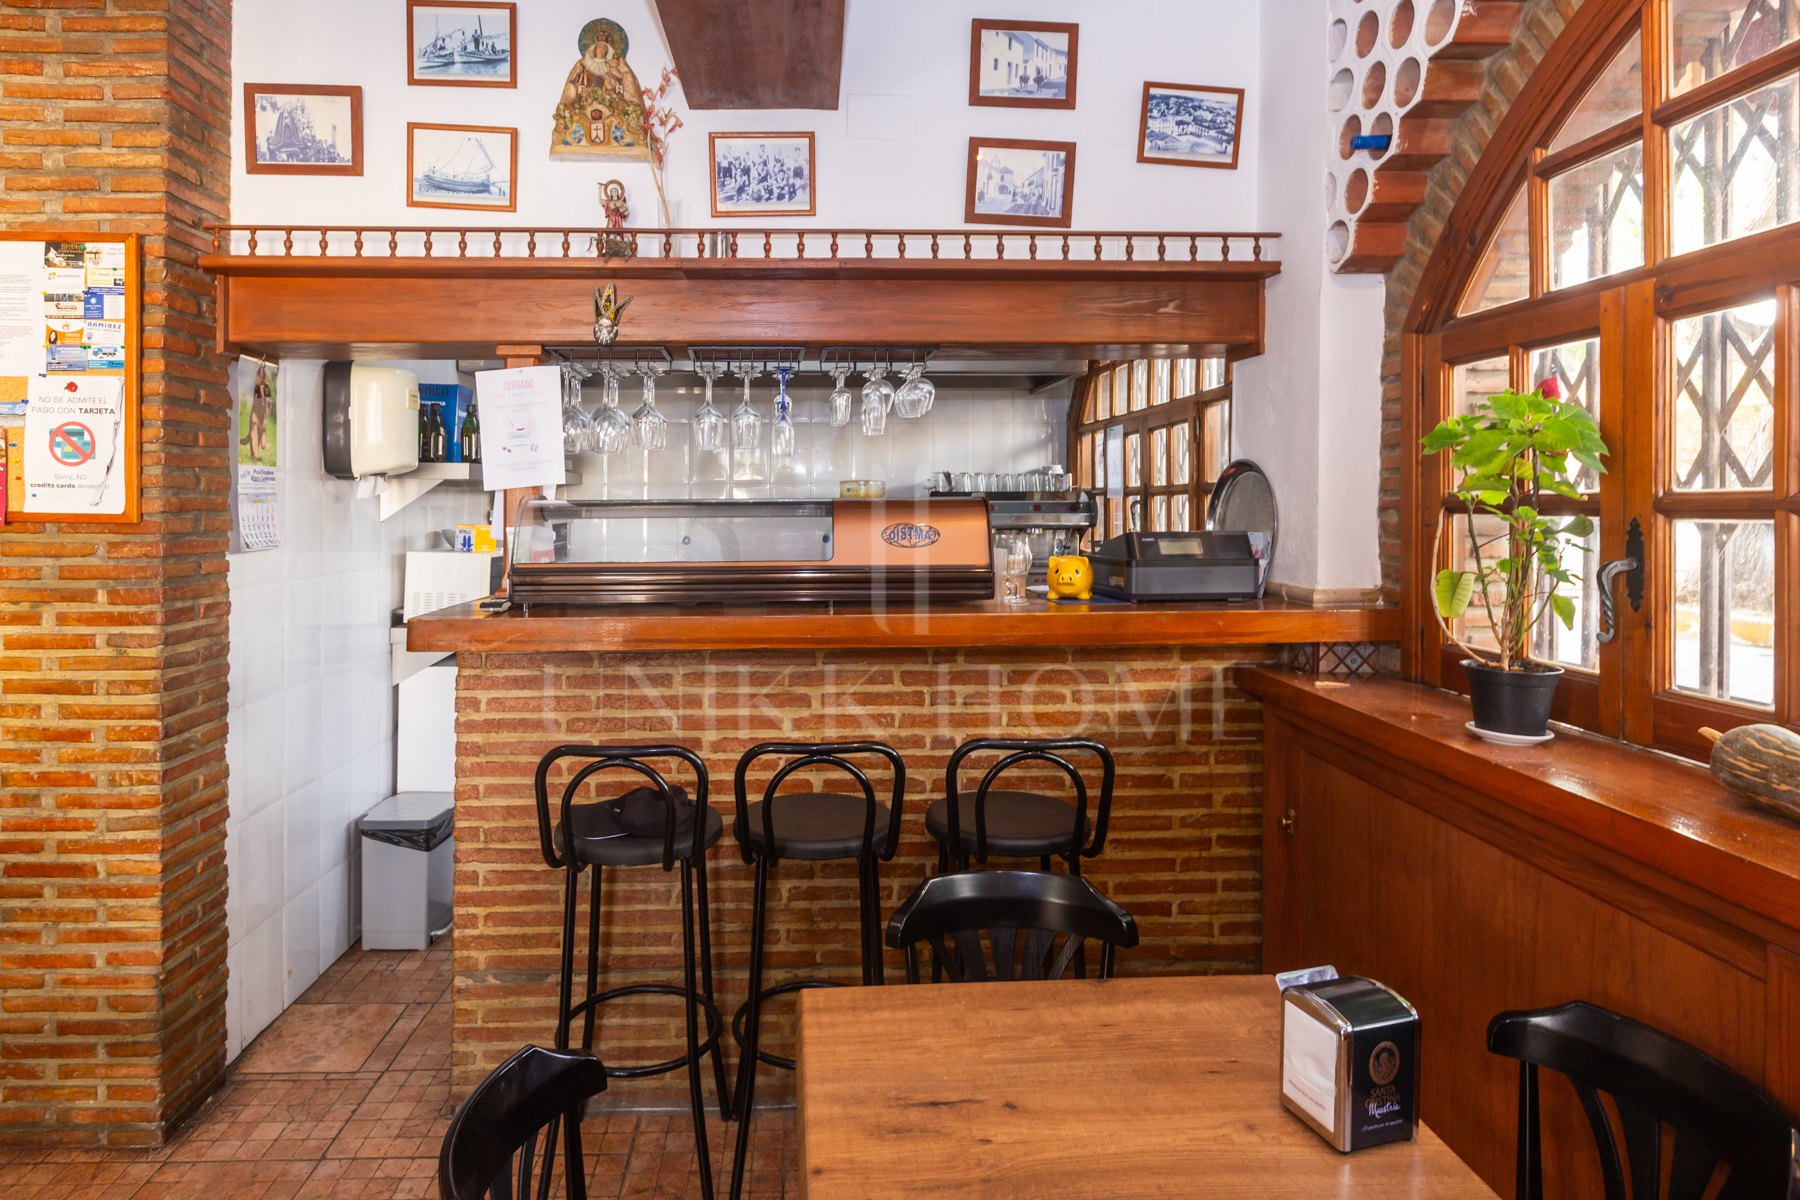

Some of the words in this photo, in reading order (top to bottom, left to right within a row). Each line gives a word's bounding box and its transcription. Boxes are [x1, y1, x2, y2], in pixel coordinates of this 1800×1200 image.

[502, 378, 534, 391] CERRADO
[38, 396, 51, 404] NO
[53, 396, 64, 404] SE
[67, 396, 98, 405] ADMITE
[99, 397, 108, 405] EL
[31, 406, 55, 414] PAGO
[78, 407, 115, 415] TARJETA
[1370, 1085, 1397, 1097] SANTA
